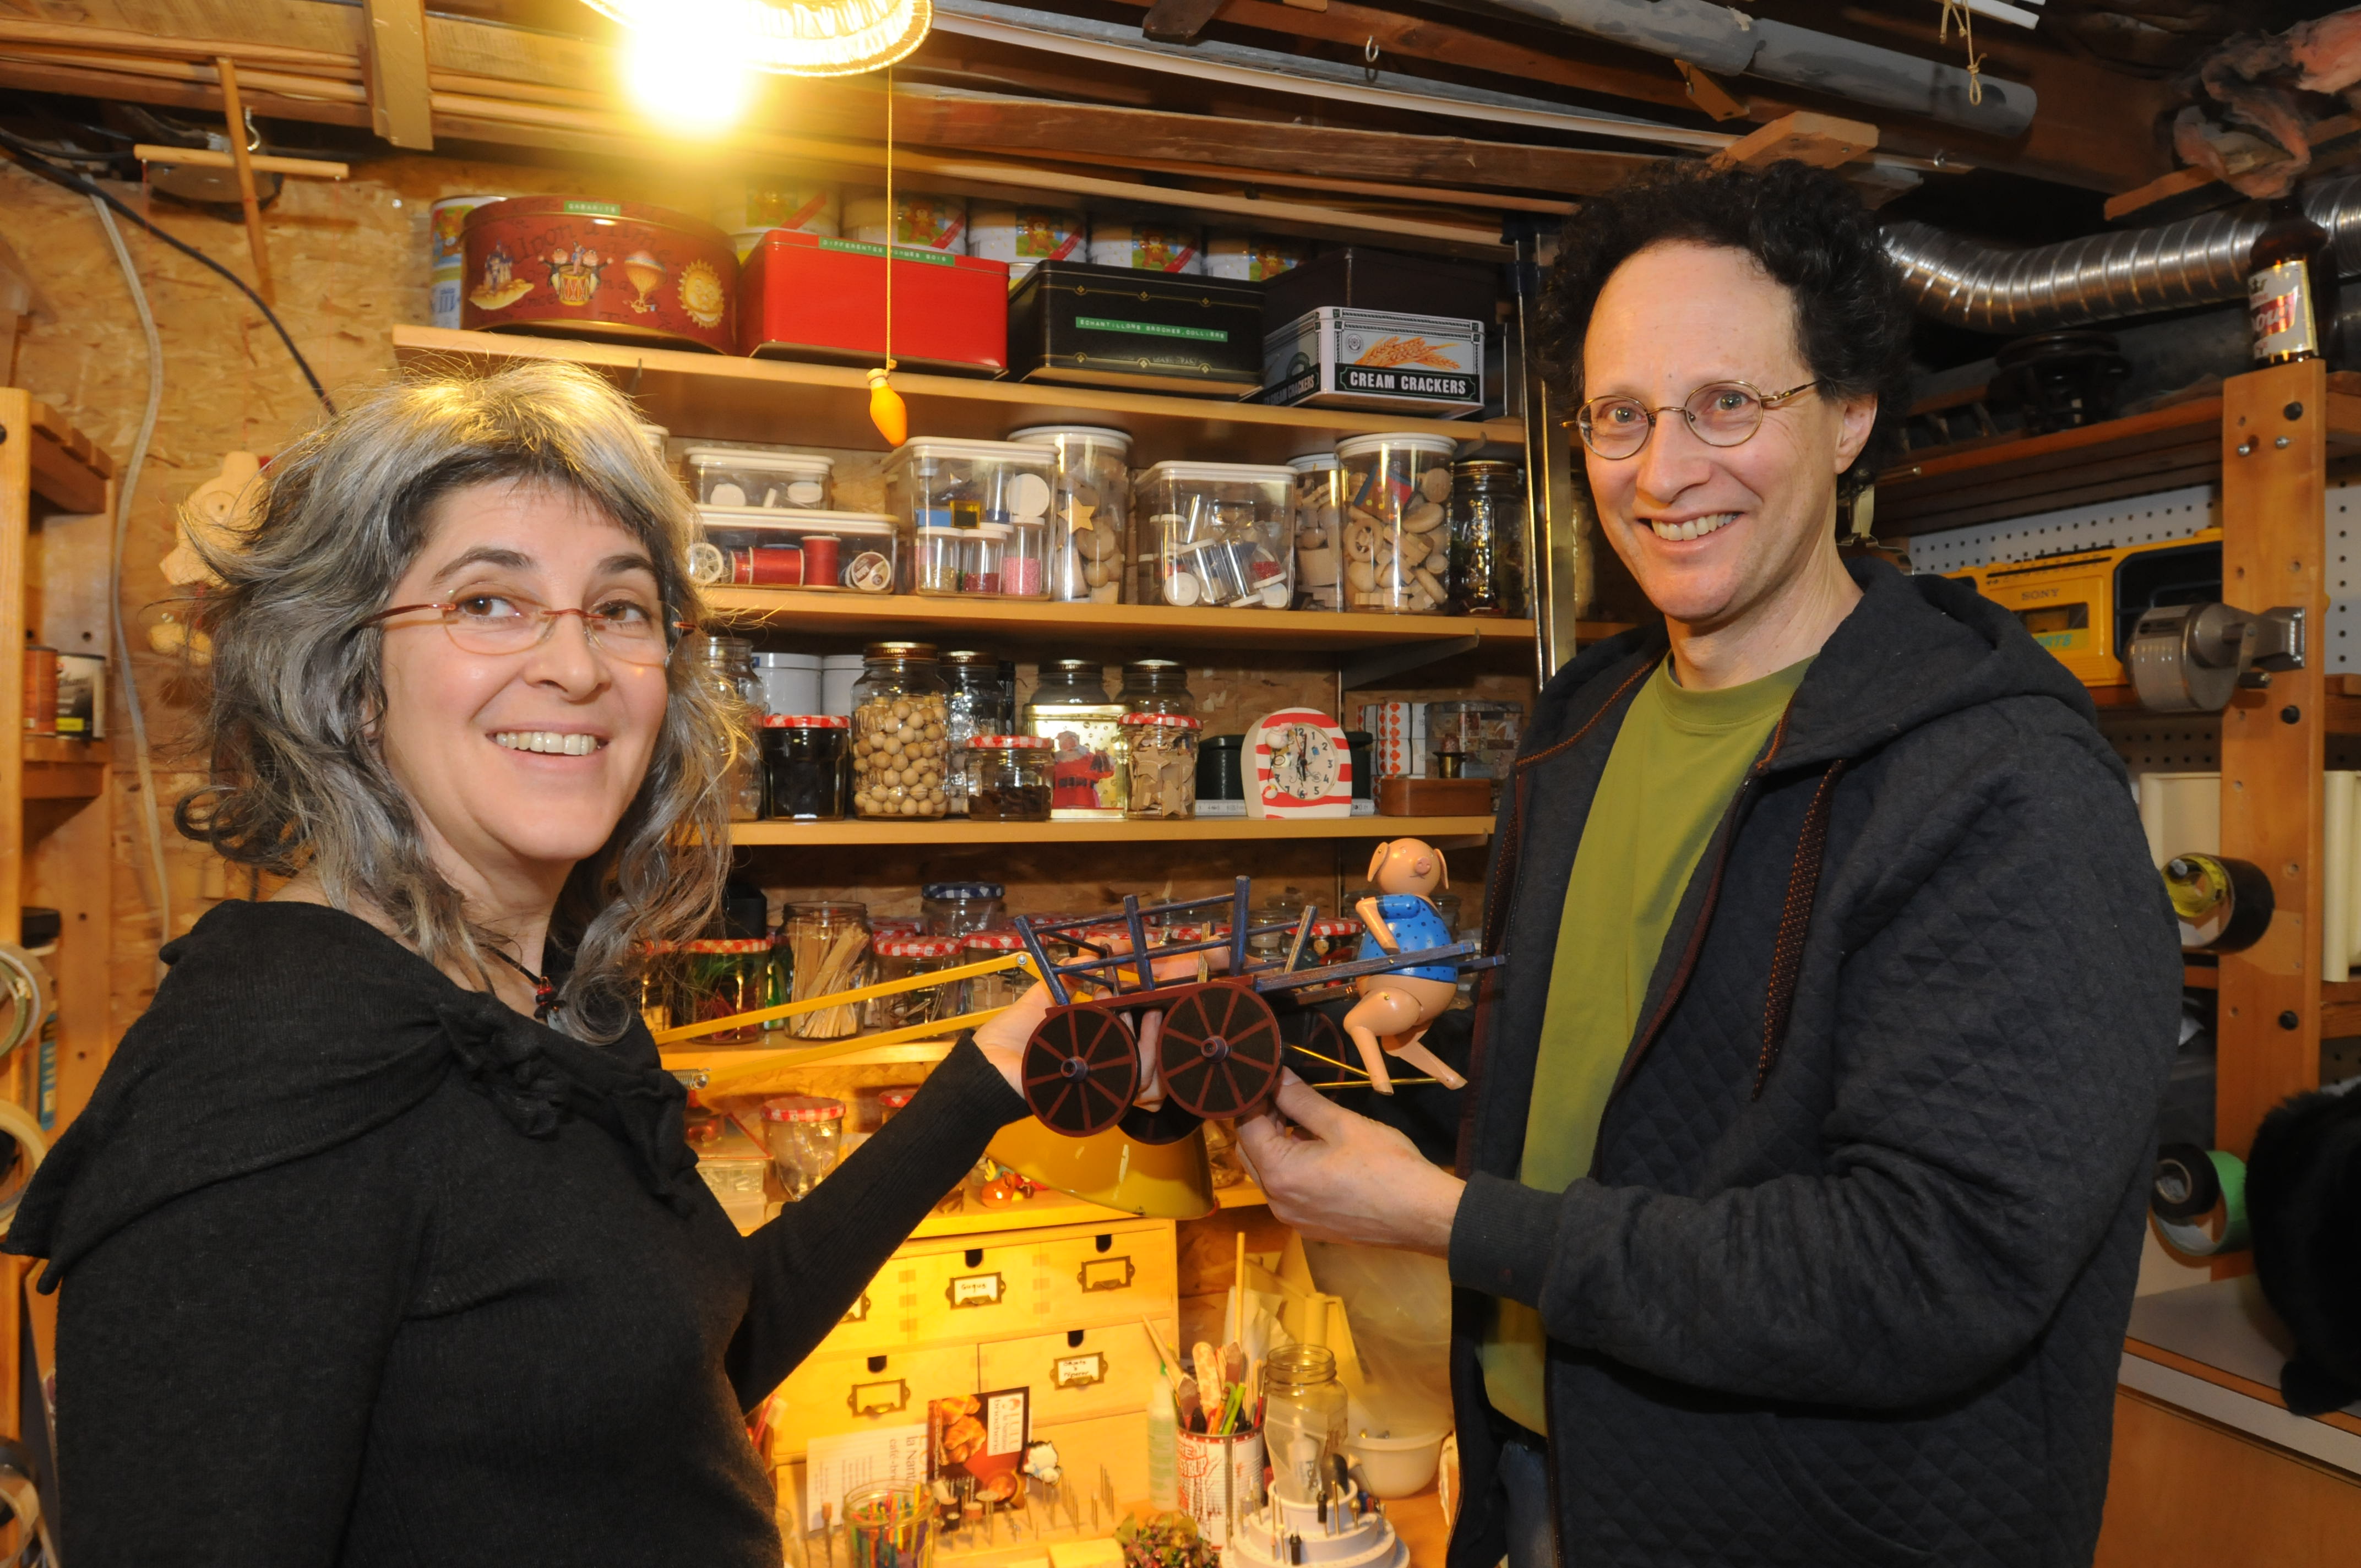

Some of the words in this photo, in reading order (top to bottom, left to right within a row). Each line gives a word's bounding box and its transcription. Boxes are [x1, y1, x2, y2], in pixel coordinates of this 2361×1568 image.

[1080, 319, 1141, 331] ECHANTILLONS
[1288, 374, 1314, 399] CRACKERS
[1350, 371, 1395, 389] CREAM
[1401, 375, 1466, 395] CRACKERS
[2021, 588, 2060, 601] SONY
[2037, 634, 2072, 648] ORTS
[1294, 728, 1304, 737] 12
[1312, 732, 1315, 740] 1
[1322, 742, 1328, 751] 2
[1328, 759, 1333, 769] 3
[1274, 774, 1280, 783] 8
[1323, 774, 1329, 783] 4
[1299, 790, 1305, 799] 6
[1314, 786, 1320, 795] 5
[906, 1436, 919, 1446] la
[906, 1450, 917, 1481] Nant
